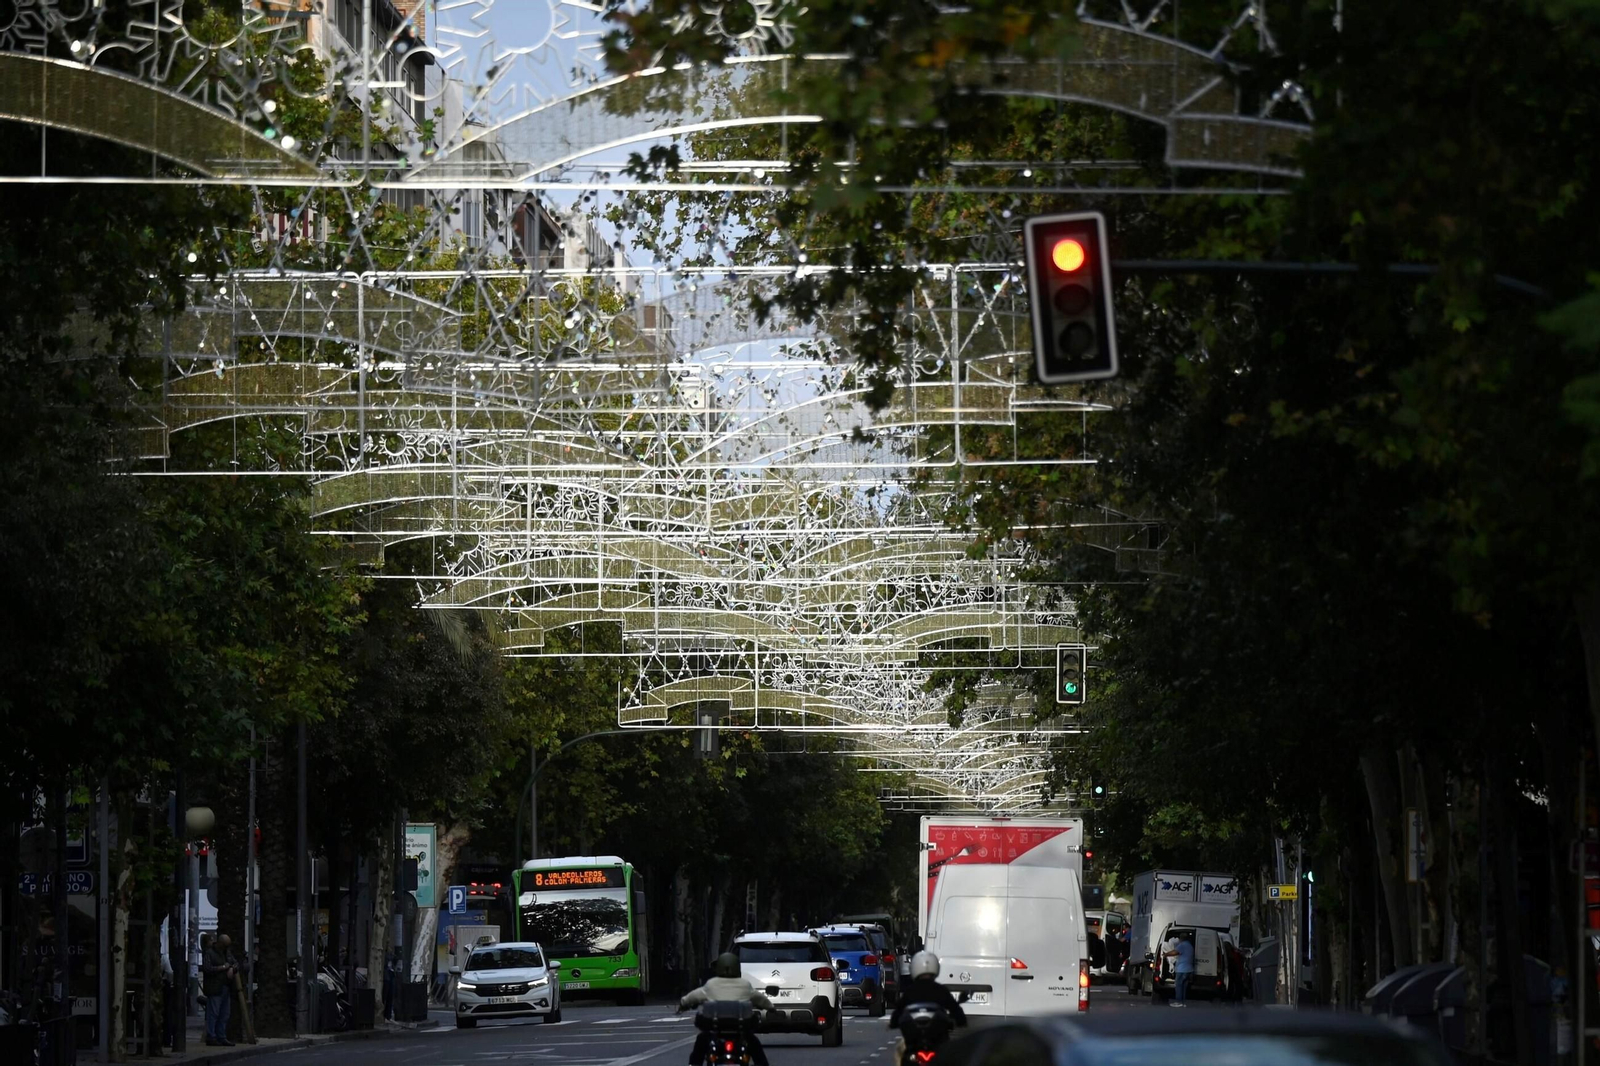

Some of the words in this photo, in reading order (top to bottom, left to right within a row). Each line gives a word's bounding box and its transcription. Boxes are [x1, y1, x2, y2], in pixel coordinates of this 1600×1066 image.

[535, 873, 543, 886] 8
[548, 871, 603, 880] VALDEOLLEROS
[1172, 881, 1192, 892] AGF
[452, 889, 463, 910] P
